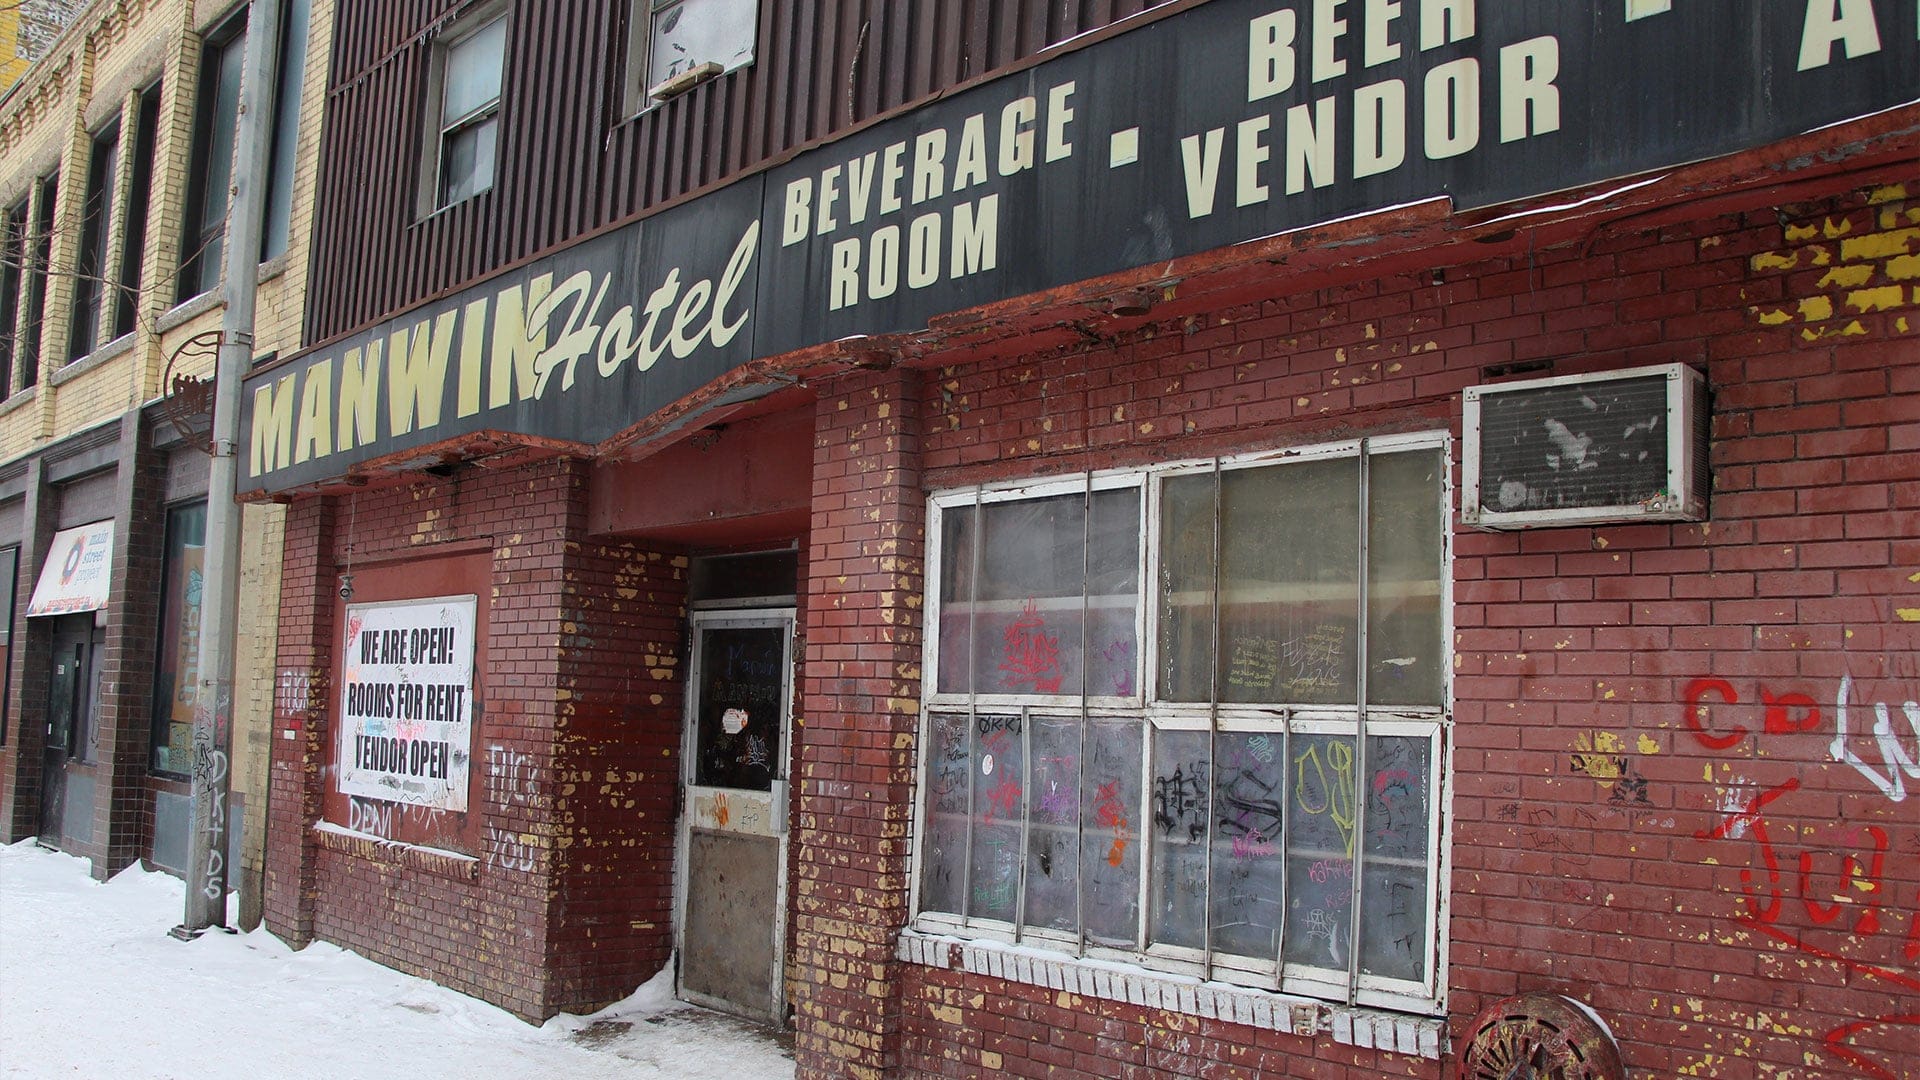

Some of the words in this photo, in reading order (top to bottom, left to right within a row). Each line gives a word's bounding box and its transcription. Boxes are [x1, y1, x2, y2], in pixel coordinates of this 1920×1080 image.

[1180, 35, 1561, 220] VENDOR
[782, 80, 1075, 248] BEVERAGE
[829, 193, 999, 312] ROOM
[249, 271, 553, 479] MANWIN
[528, 219, 759, 401] Hotel
[82, 550, 106, 564] street
[361, 630, 379, 665] WE
[381, 628, 408, 665] ARE
[410, 627, 455, 665] OPEN!
[348, 682, 395, 719] ROOMS
[397, 683, 424, 721] FOR
[426, 684, 465, 722] RENT
[355, 735, 407, 775] VENDOR
[410, 739, 449, 780] OPEN
[487, 745, 540, 812] FUCK
[486, 820, 536, 873] YOU
